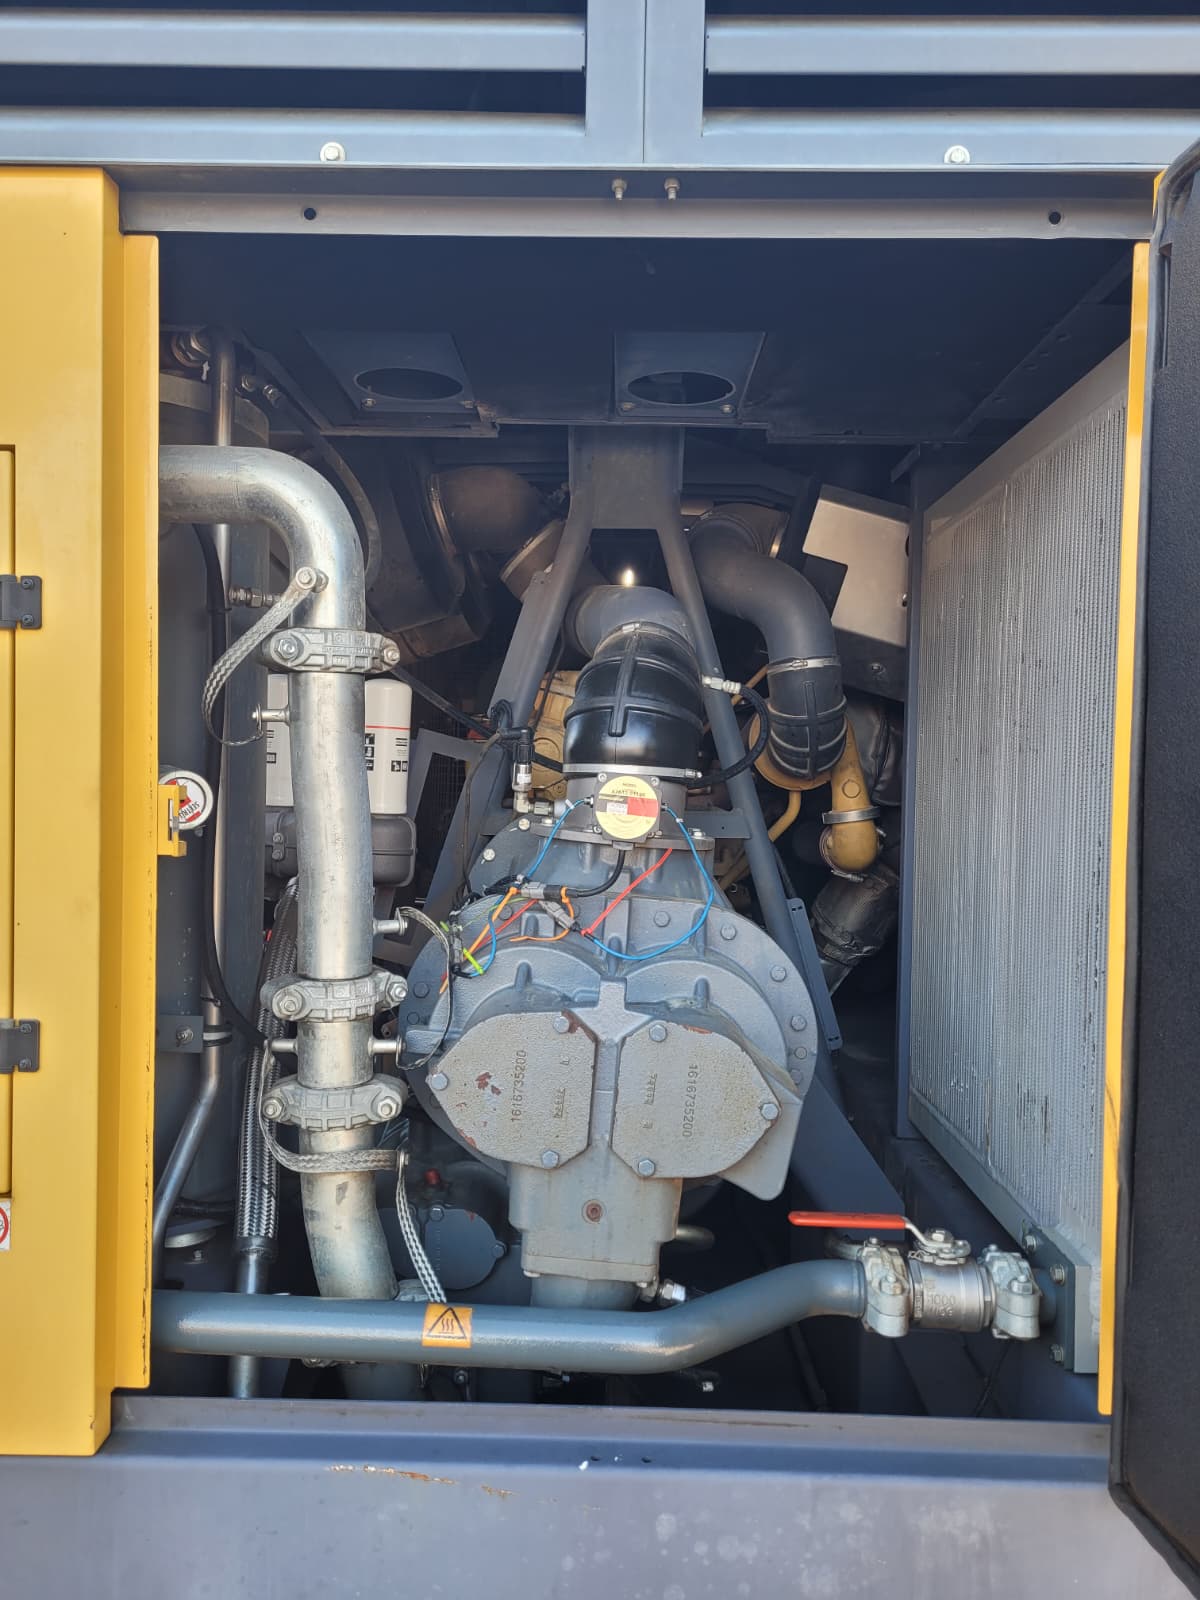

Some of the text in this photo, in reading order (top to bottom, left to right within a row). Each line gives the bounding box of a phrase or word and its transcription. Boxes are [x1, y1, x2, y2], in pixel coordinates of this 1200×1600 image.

[511, 1049, 527, 1123] 1616735200
[682, 1064, 699, 1137] 1616735200
[930, 1294, 956, 1306] 1000
